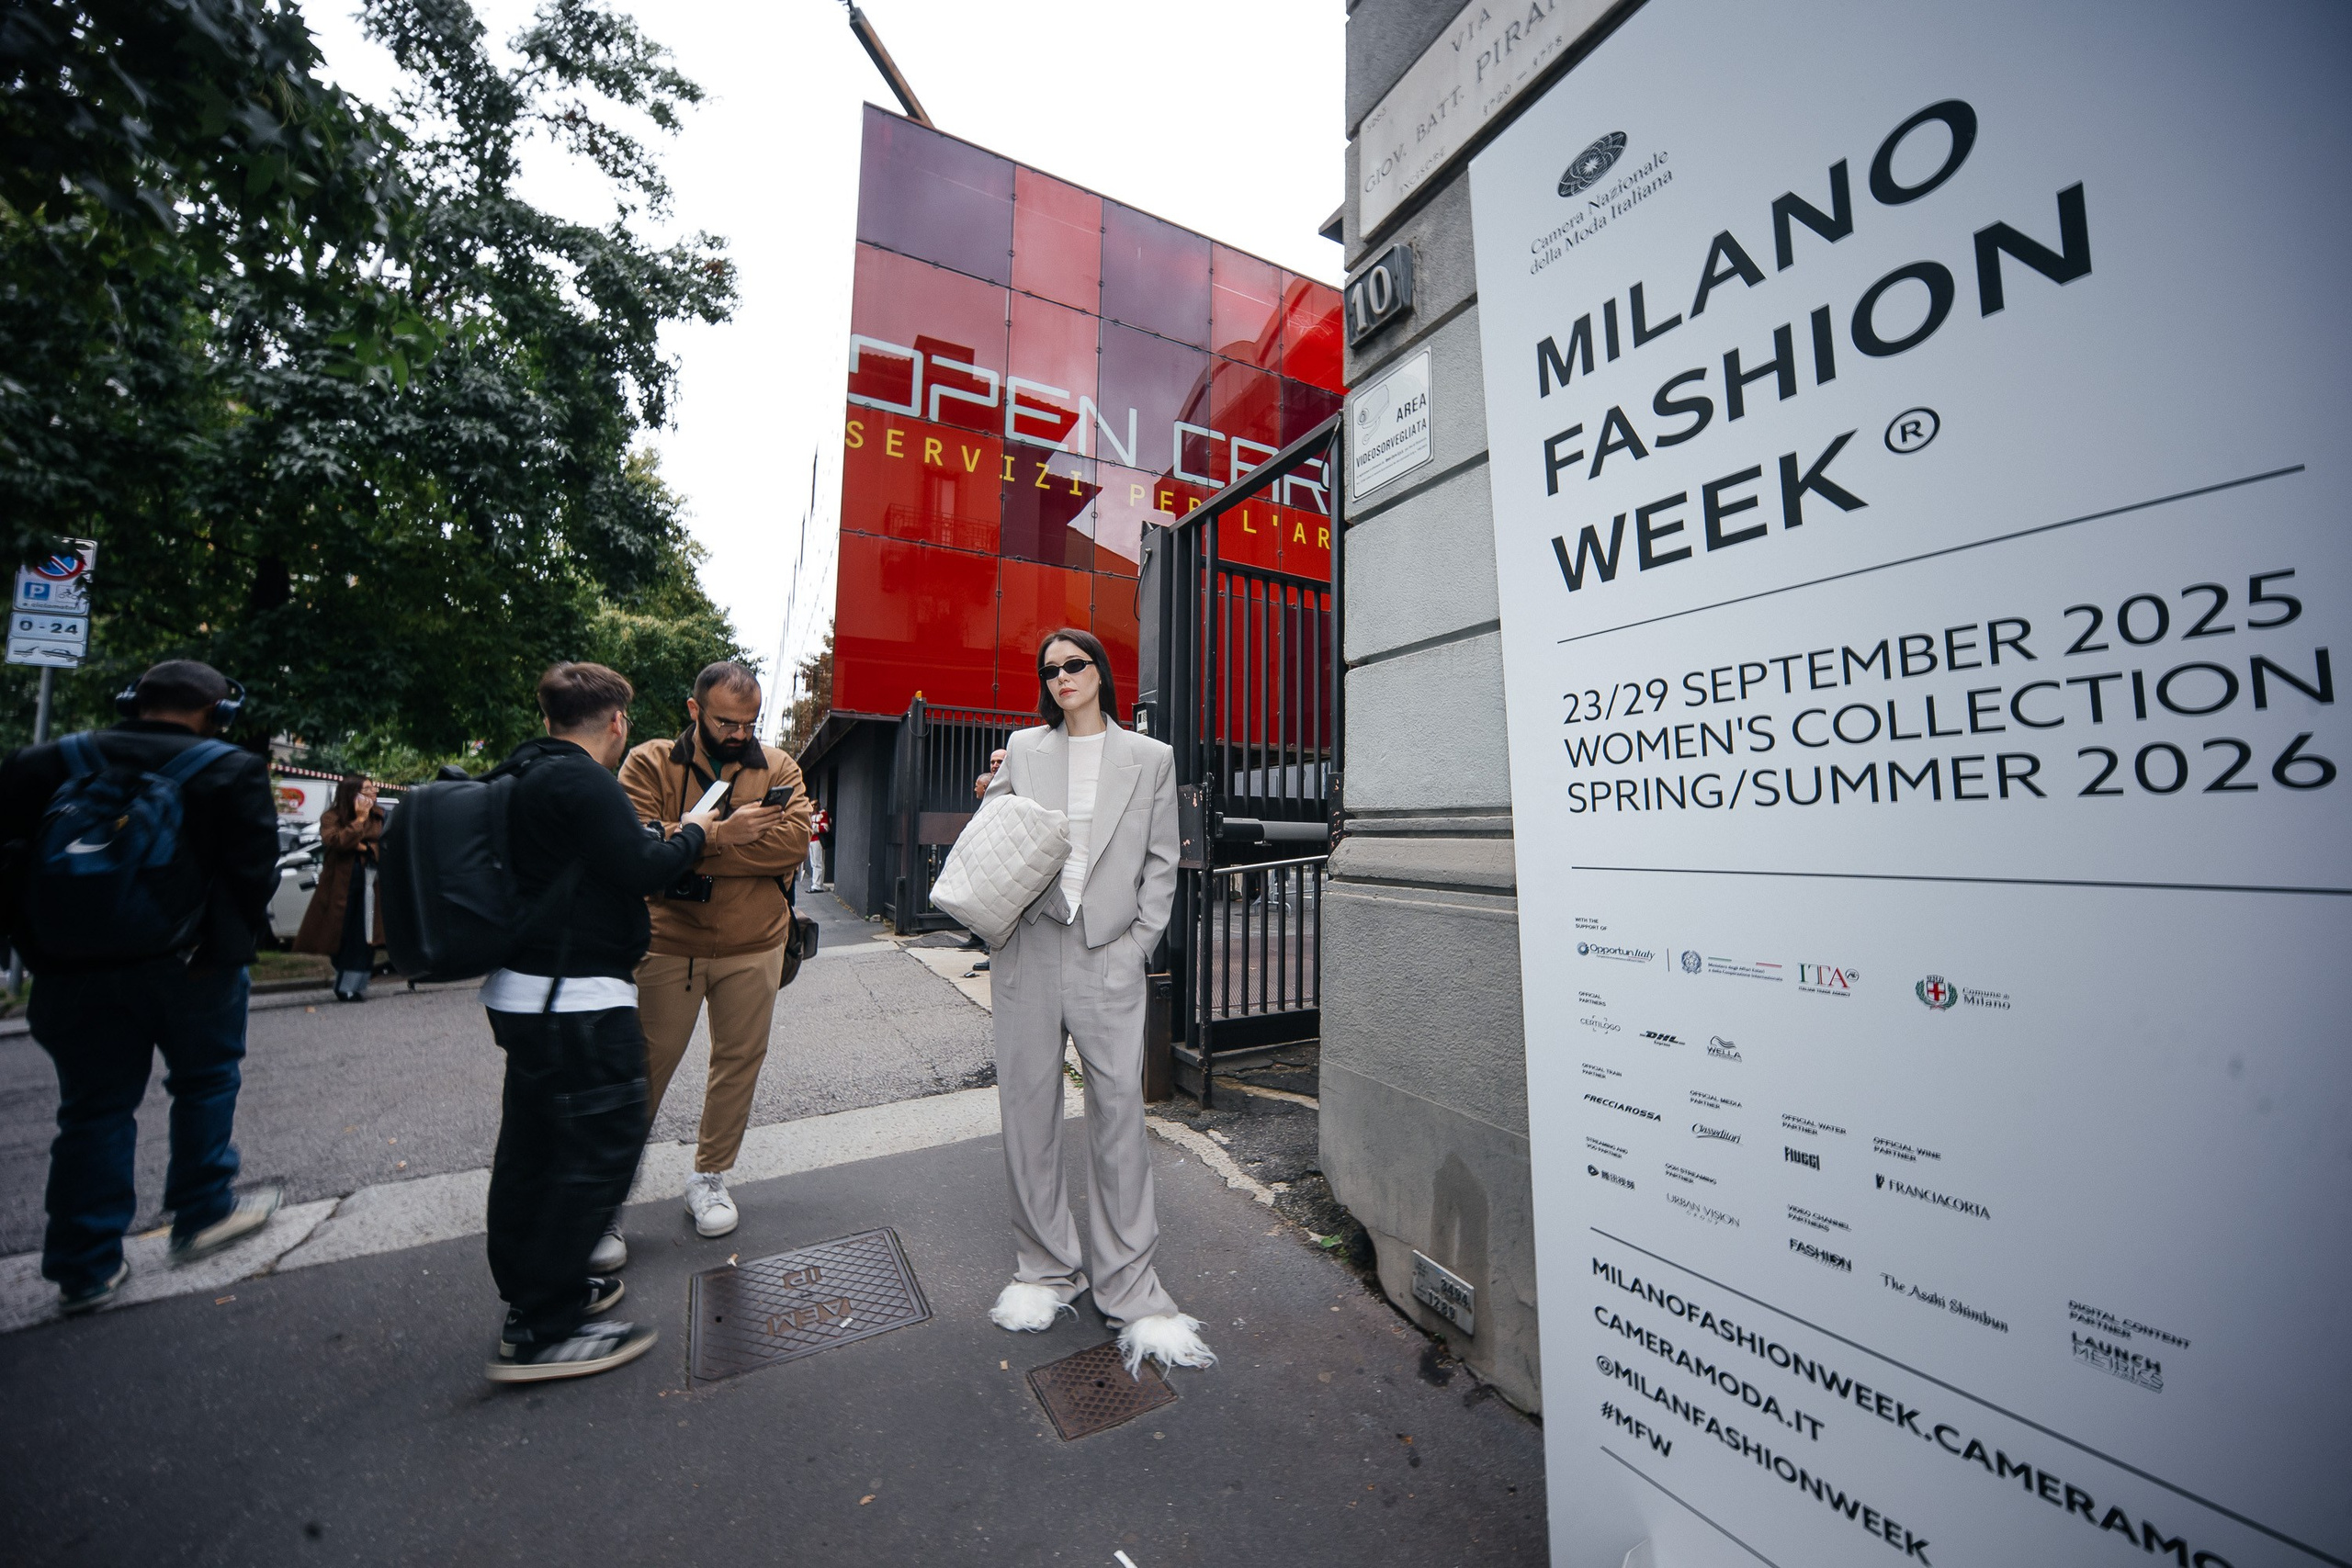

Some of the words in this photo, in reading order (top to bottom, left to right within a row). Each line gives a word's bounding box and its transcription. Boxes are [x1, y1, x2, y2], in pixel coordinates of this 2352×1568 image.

[1452, 7, 1492, 52] VIA
[1363, 143, 1407, 194] GIOV.
[1416, 85, 1465, 144] BATT.
[1531, 211, 1584, 255] Camera
[1588, 150, 1669, 216] Nazionale
[1530, 247, 1563, 276] della
[1565, 215, 1608, 253] Moda
[1610, 169, 1674, 220] Italiana
[1535, 98, 1979, 399] MILANO
[1351, 265, 1392, 332] 10
[1543, 180, 2093, 497] FASHION
[847, 333, 1138, 468] OPEN
[1396, 392, 1427, 423] AREA
[844, 419, 1083, 498] SERVIZI
[1355, 418, 1427, 468] VIDEOSORVEGLIATA
[1551, 427, 1870, 593] WEEK
[51, 623, 78, 635] 24
[1562, 679, 1668, 725] 23/29
[1682, 616, 2037, 708] SEPTEMBER
[2064, 567, 2304, 656] 2025
[1563, 716, 1776, 770] WOMEN'S
[1791, 647, 2335, 748] COLLECTION
[1567, 750, 2048, 814] SPRING/SUMMER
[2077, 731, 2338, 798] 2026
[1797, 962, 1850, 989] ITA
[1578, 990, 1601, 999] OFFICIAL
[1578, 998, 1606, 1007] PARTNERS
[1962, 987, 2001, 998] Comune
[1964, 994, 2011, 1010] Milano
[1579, 1017, 1622, 1032] CERTILOGO
[1645, 1030, 1679, 1044] DHL
[1706, 1045, 1742, 1058] WELLA
[1581, 1062, 1604, 1073] OFFICIAL
[1606, 1067, 1623, 1077] TRAIN
[1582, 1069, 1607, 1079] PARTNER
[1583, 1093, 1662, 1122] FRECCIAROSSA
[1690, 1089, 1719, 1101] OFFICIAL
[1720, 1096, 1743, 1108] MEDIA
[1690, 1098, 1721, 1110] PARTNER
[1781, 1112, 1815, 1127] OFFICIAL
[1817, 1121, 1847, 1135] WATER
[1781, 1122, 1818, 1136] PARTNER
[1598, 1147, 1623, 1159] PARTNER
[1784, 1145, 1821, 1171] FIUGGI
[1872, 1136, 1915, 1153] OFFICIAL
[1917, 1147, 1941, 1161] WINE
[1873, 1145, 1917, 1163] PARTNER
[1665, 1170, 1694, 1184] PARTNER
[1667, 1192, 1700, 1213] URBAN
[1702, 1205, 1740, 1227] VISION
[1889, 1179, 1991, 1220] FRANCIACORTA
[1787, 1202, 1812, 1217] VIDEO
[1813, 1212, 1852, 1232] CHANNEL
[1788, 1212, 1830, 1233] PARTNERS
[771, 1297, 844, 1334] AEM
[1880, 1271, 1905, 1293] The
[1907, 1284, 1946, 1309] Asahi
[1949, 1298, 2009, 1334] Shimbun
[2068, 1299, 2120, 1325] DIGITAL
[2121, 1318, 2192, 1350] CONTENT
[2069, 1310, 2132, 1340] PARTNER
[2071, 1330, 2162, 1374] LAUNCH
[2072, 1342, 2165, 1391] METRICS
[1594, 1305, 1826, 1442] CAMERAMODA.IT
[1600, 1400, 1673, 1458] #MFW
[1596, 1354, 1934, 1567] @MILANFASHIONWEEK
